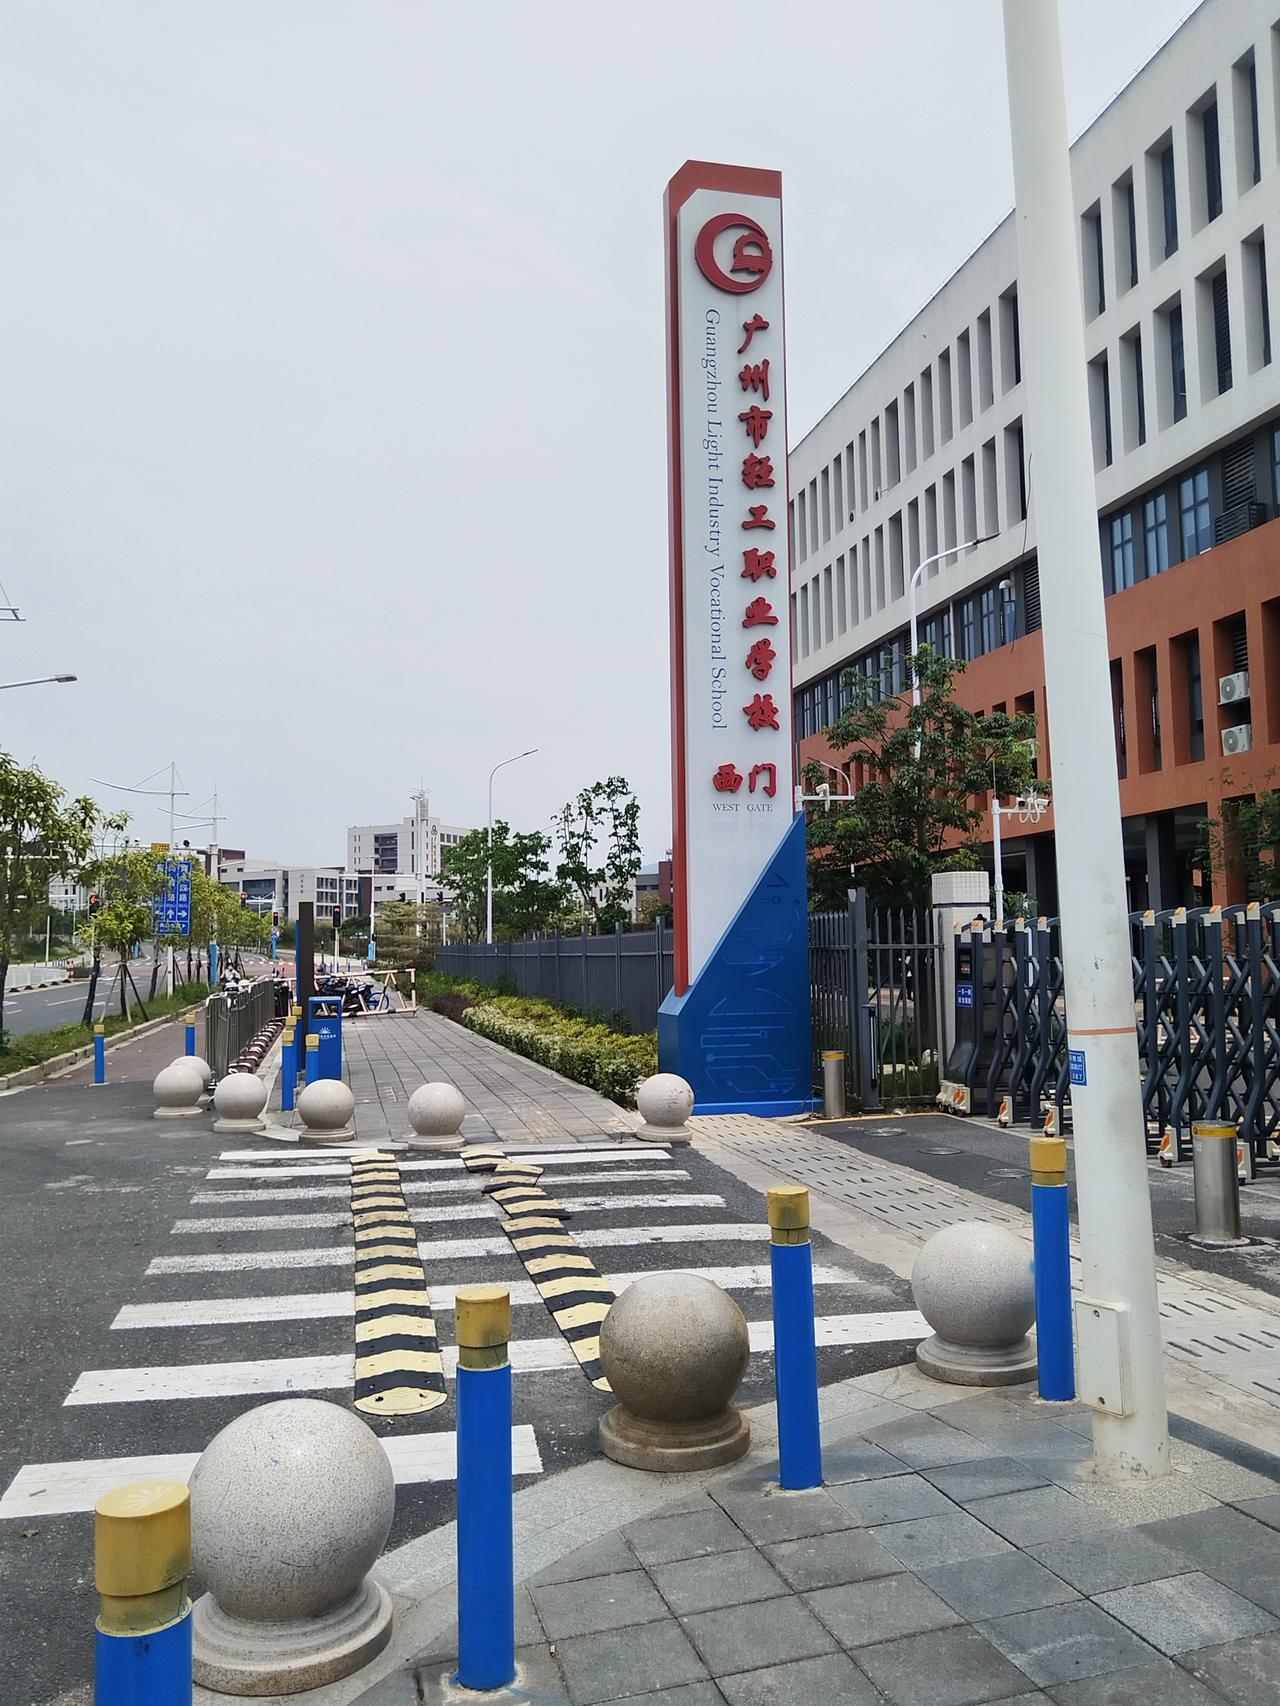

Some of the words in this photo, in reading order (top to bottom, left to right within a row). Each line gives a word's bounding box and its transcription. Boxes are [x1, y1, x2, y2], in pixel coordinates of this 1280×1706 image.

[701, 309, 723, 412] Guangzhou
[702, 419, 723, 470] Light
[704, 476, 725, 559] Industry
[736, 313, 779, 730] 广州市轻工职业学校
[708, 564, 727, 661] Vocational
[710, 667, 728, 730] School
[712, 803, 740, 812] WEST
[746, 803, 773, 812] GATE
[713, 763, 777, 798] 西门
